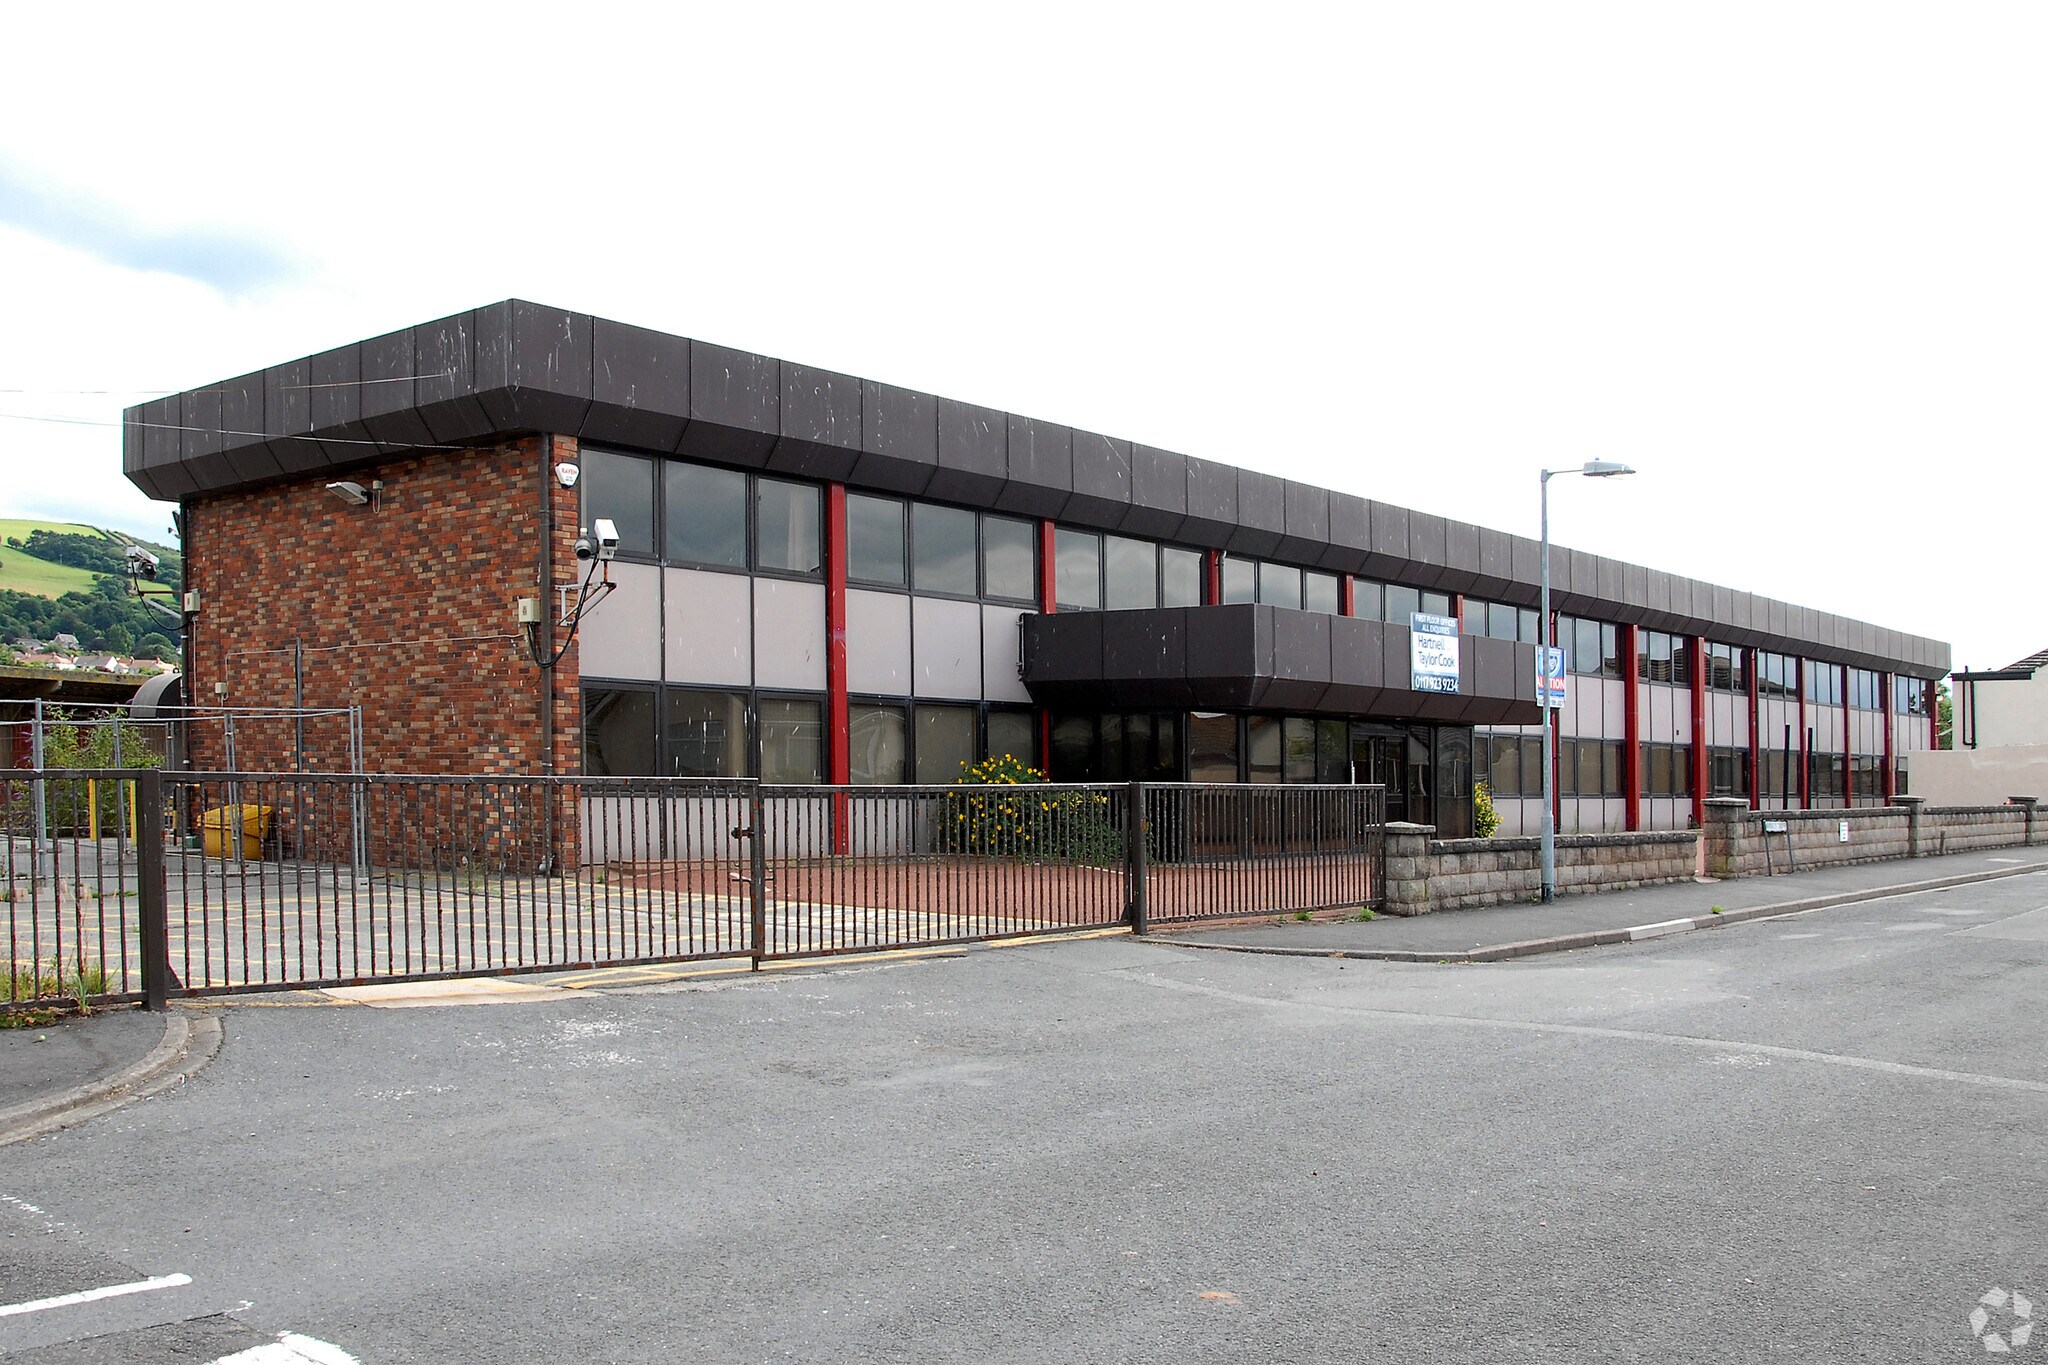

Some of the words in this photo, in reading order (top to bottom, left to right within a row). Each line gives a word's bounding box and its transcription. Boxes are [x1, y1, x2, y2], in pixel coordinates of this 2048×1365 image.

[1418, 635, 1445, 650] Hartnell
[1418, 651, 1437, 668] Taylor
[1438, 653, 1456, 667] Cook
[1415, 675, 1429, 689] 0117
[1429, 676, 1442, 690] 923
[1443, 678, 1459, 692] 9234
